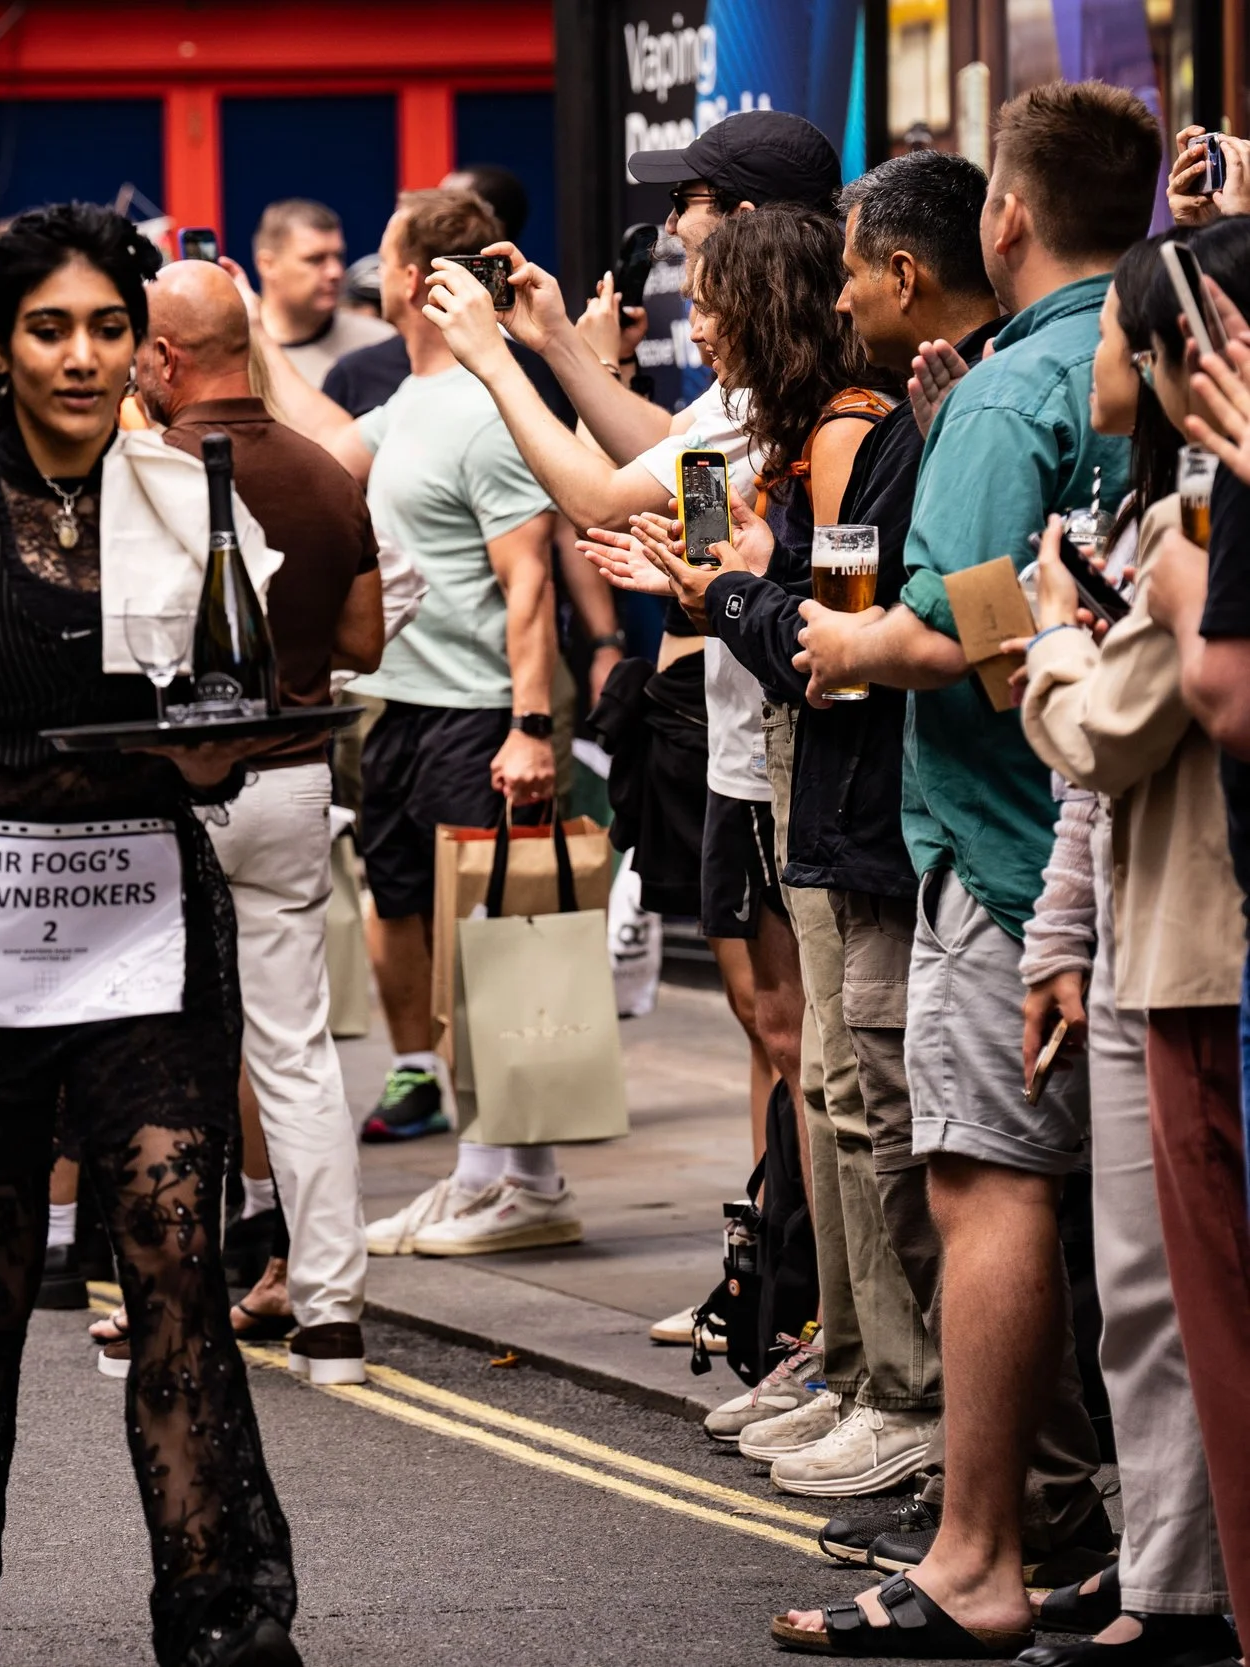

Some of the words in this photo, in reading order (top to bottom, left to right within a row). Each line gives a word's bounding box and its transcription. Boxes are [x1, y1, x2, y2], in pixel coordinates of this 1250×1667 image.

[623, 11, 717, 104] Vaping
[32, 849, 130, 874] FOGG'S
[43, 921, 57, 942] 2
